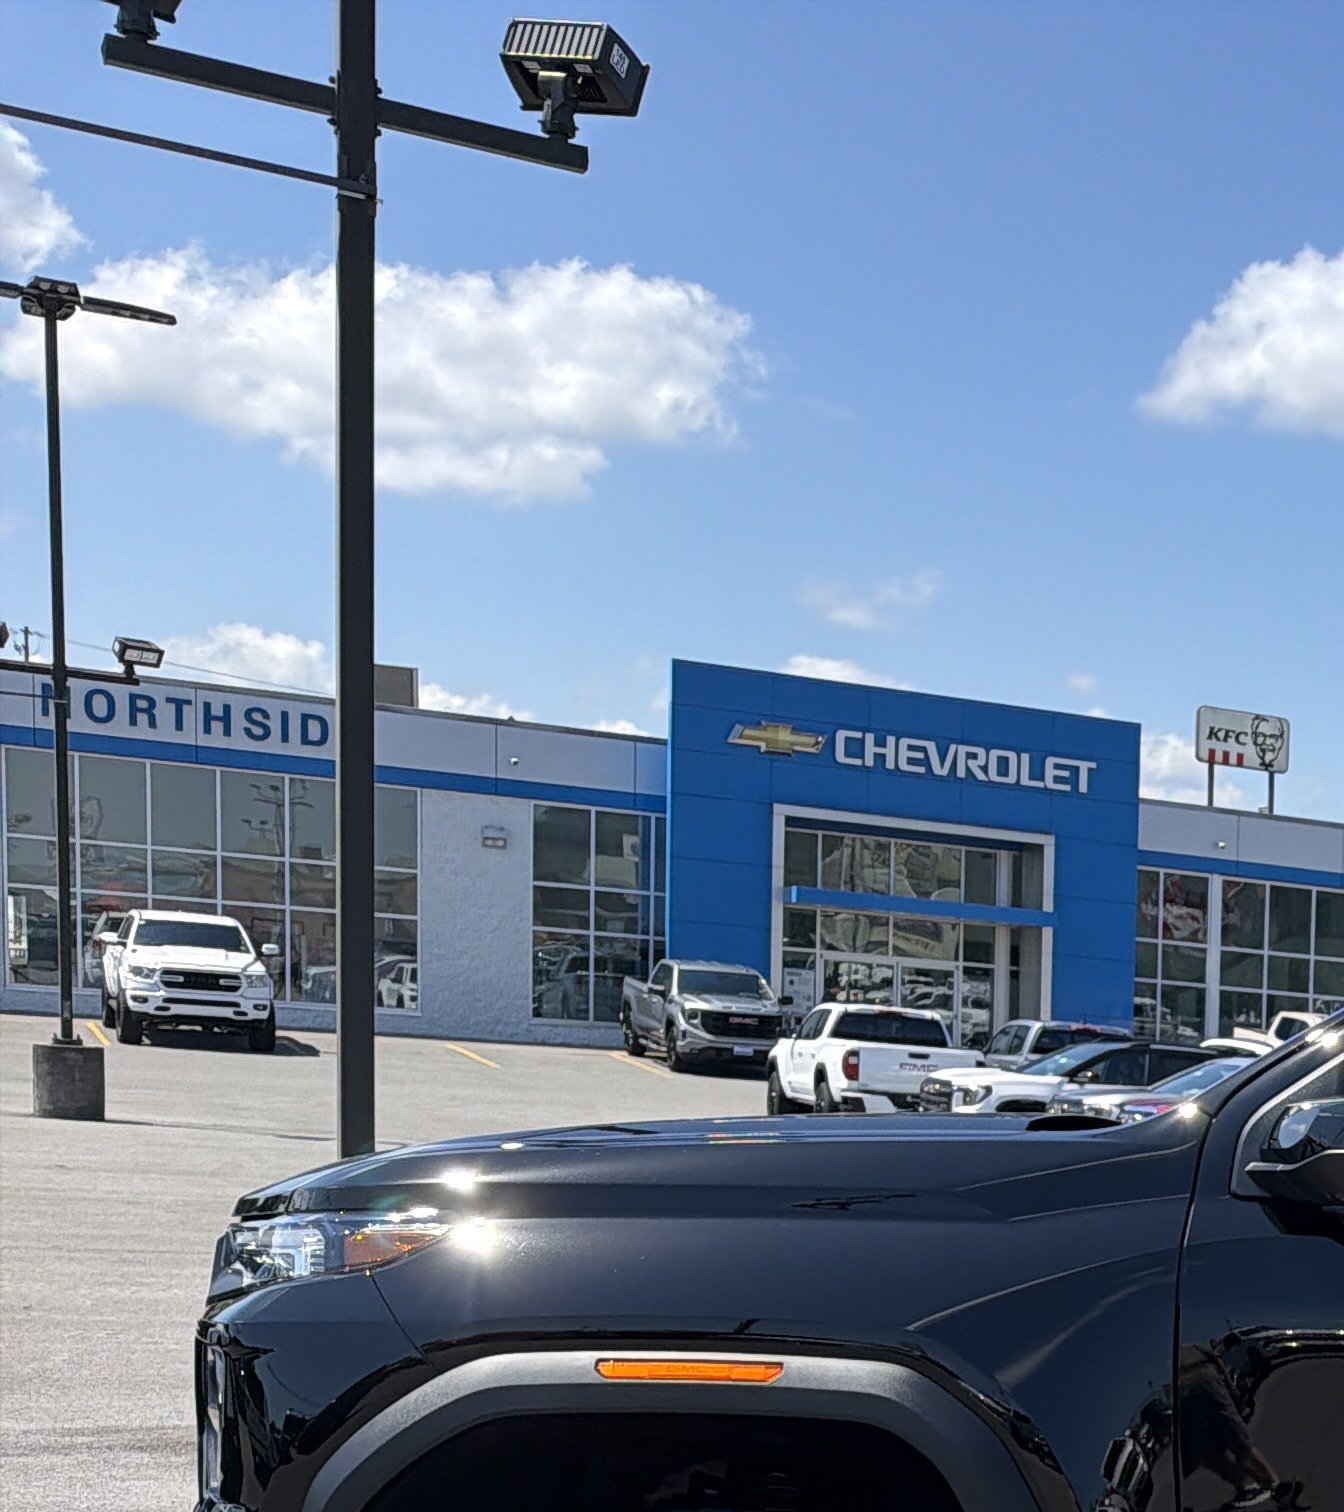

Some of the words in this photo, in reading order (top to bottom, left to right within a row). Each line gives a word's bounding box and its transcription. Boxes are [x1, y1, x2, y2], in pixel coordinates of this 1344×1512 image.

[41, 682, 330, 747] NORTHSID
[1206, 725, 1250, 747] KFC
[834, 729, 1097, 795] CHEVROLET
[899, 1061, 939, 1073] GMC
